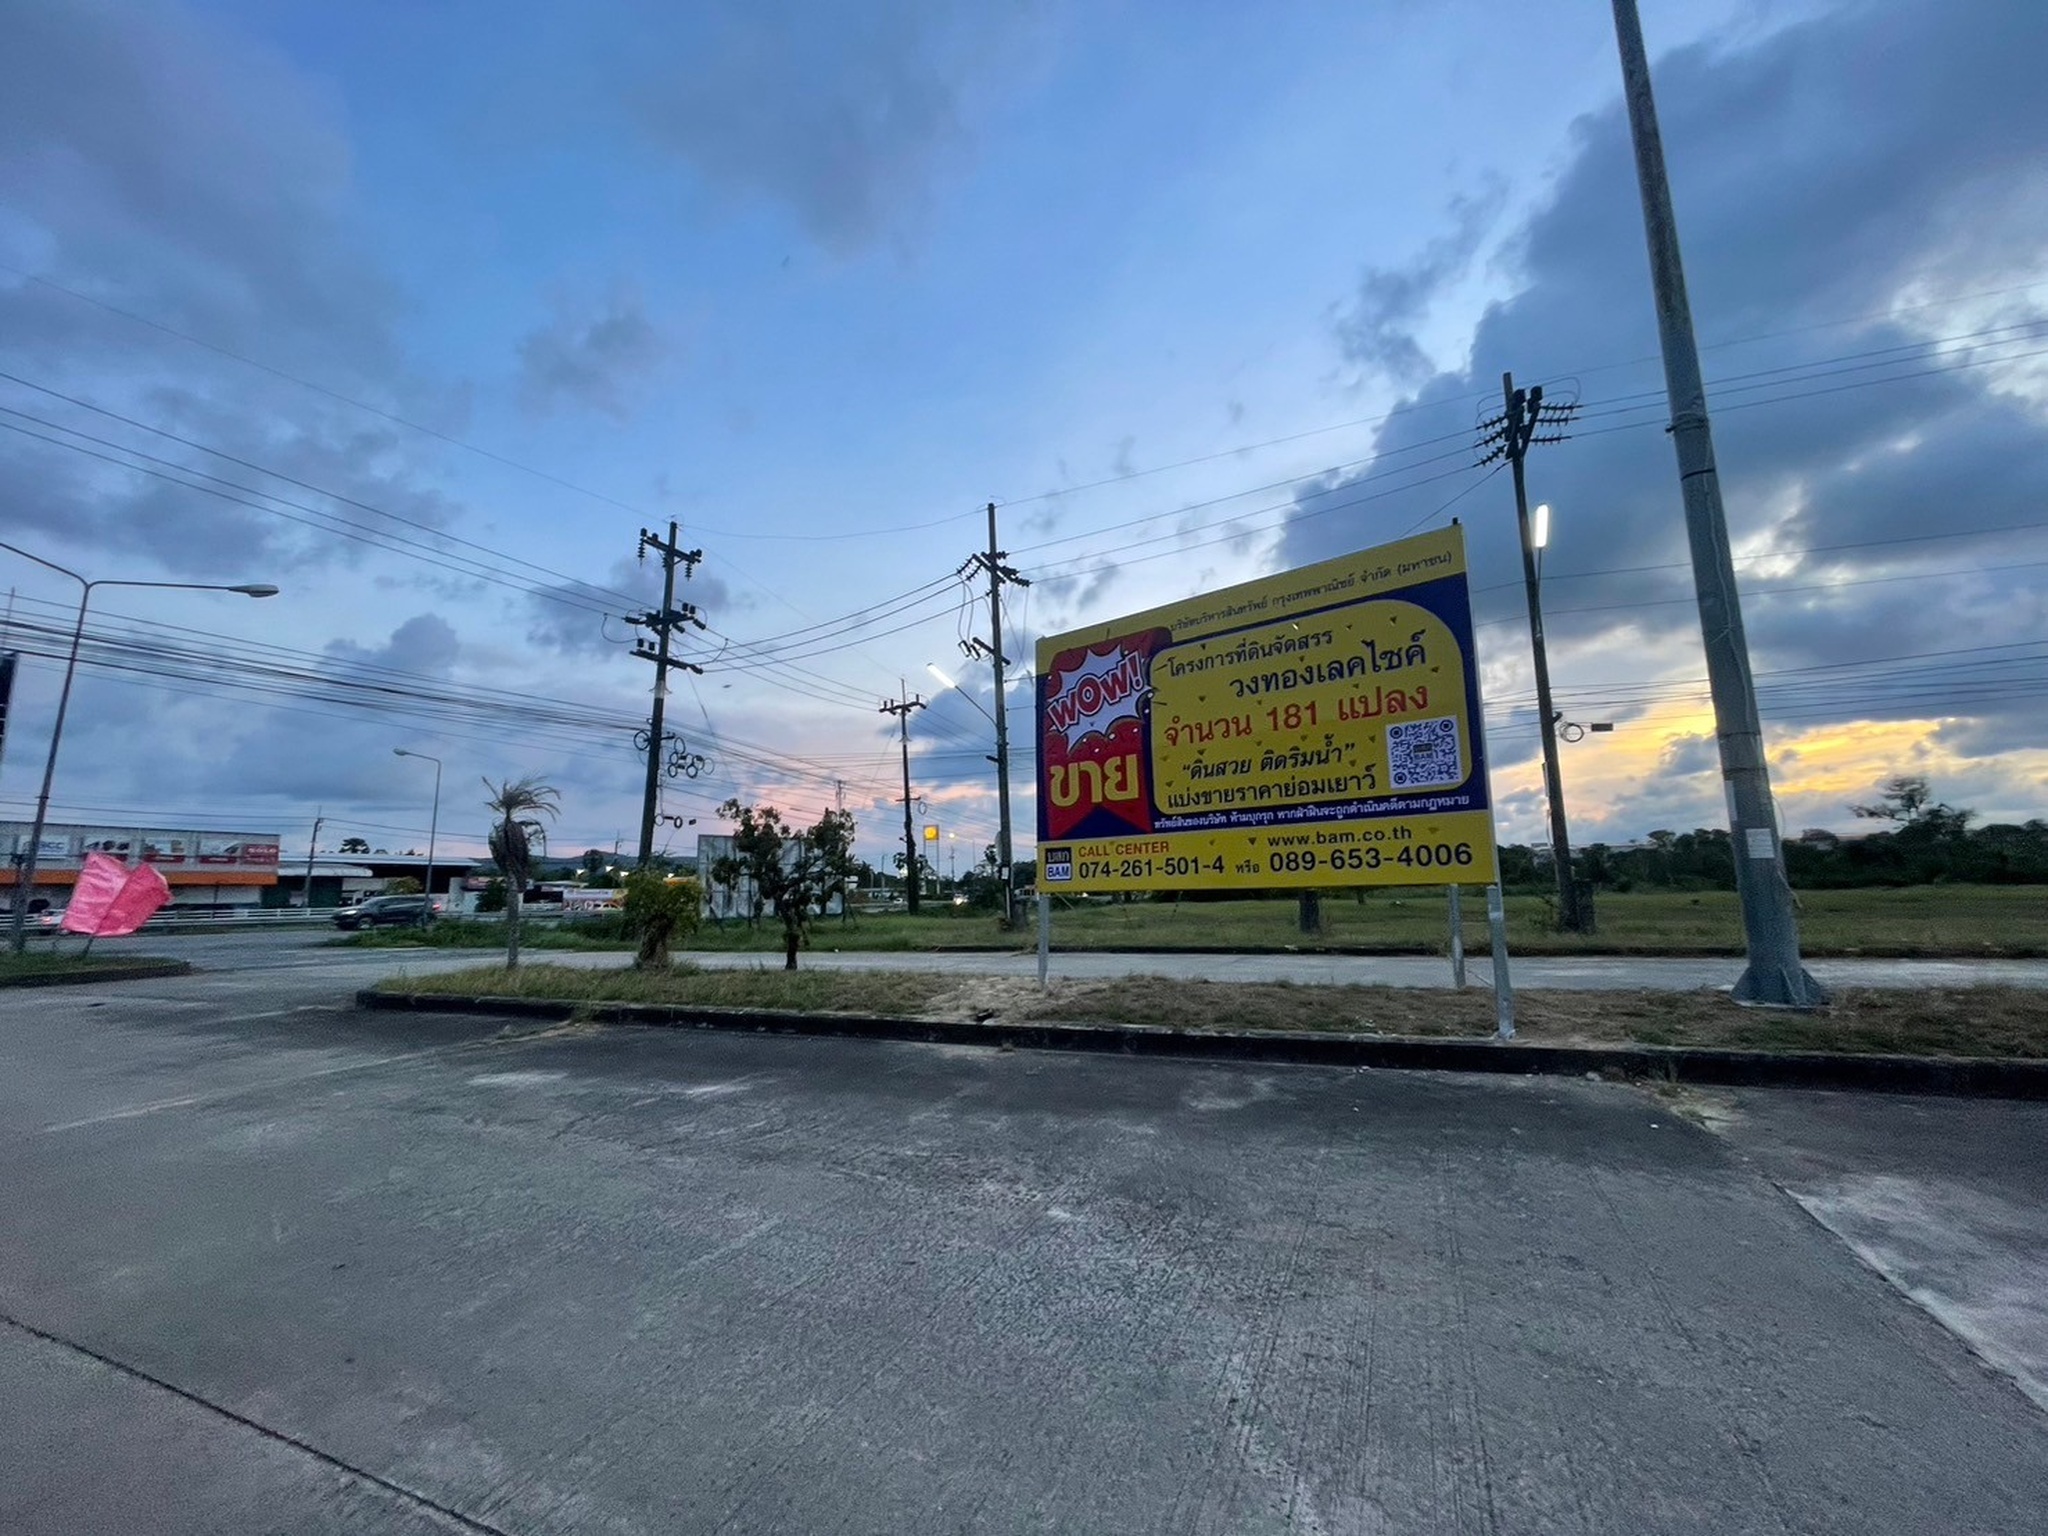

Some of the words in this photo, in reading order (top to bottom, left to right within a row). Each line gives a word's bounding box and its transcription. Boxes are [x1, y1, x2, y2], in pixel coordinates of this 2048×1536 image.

[1361, 567, 1391, 582] จำกัด
[1397, 551, 1452, 576] (มหาชน)
[1167, 630, 1333, 677] โครงการที่ดินจัดสรร
[1047, 651, 1144, 733] WOW!
[1164, 713, 1252, 747] จำนวน
[1266, 700, 1319, 732] 181
[1338, 685, 1429, 722] แปลง
[1050, 753, 1139, 807] ขาย
[1167, 764, 1377, 809] แบ่งขายราคาย่อมเยาว์
[1078, 846, 1110, 858] CALL
[1115, 841, 1170, 855] CENTER
[1267, 826, 1412, 847] www.bam.co.th
[1047, 866, 1070, 878] BAM
[1079, 855, 1225, 879] 074-261-501-4
[1235, 859, 1260, 874] หรือ
[1269, 842, 1473, 872] 089-653-4006
